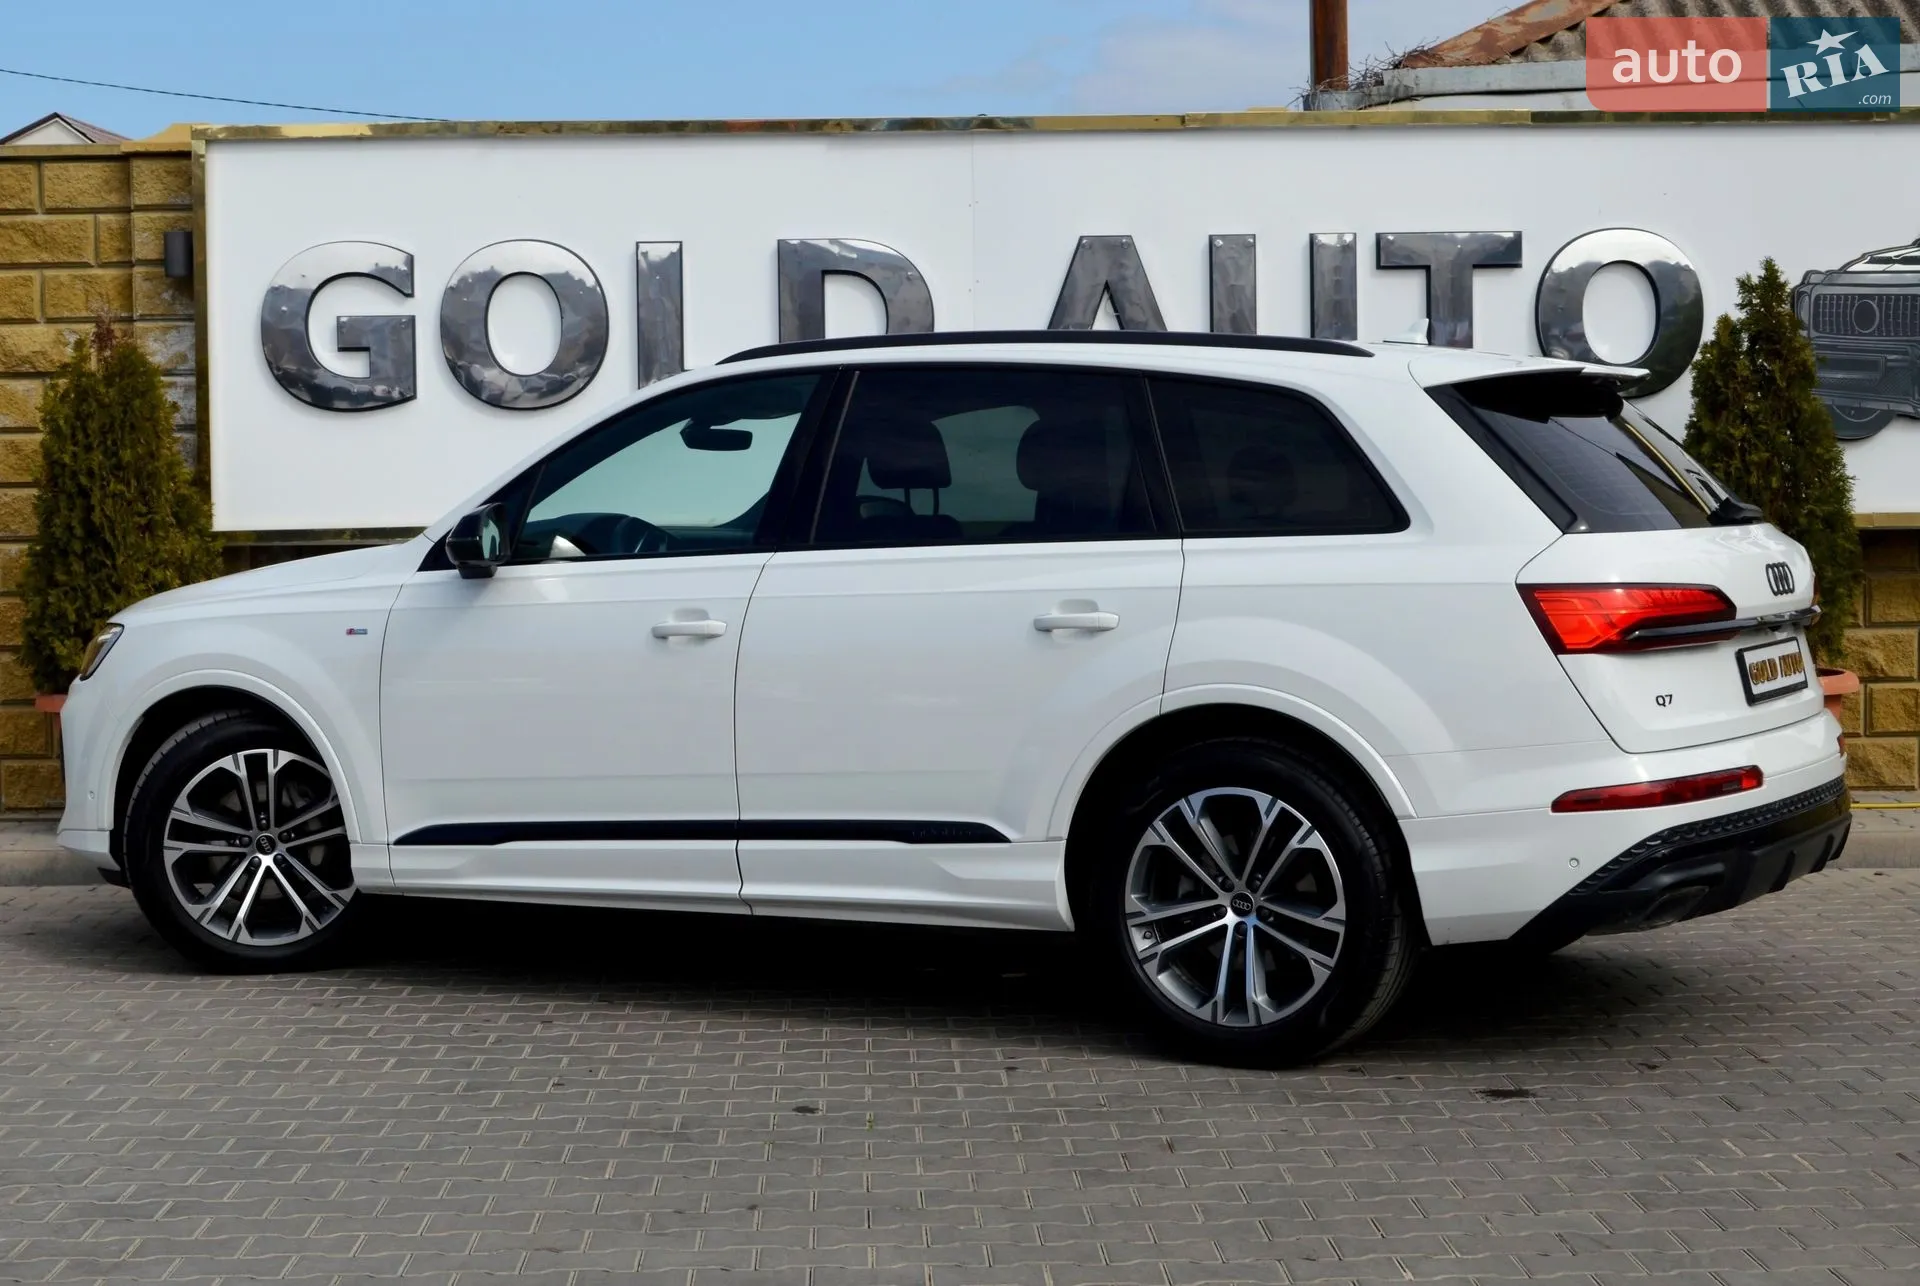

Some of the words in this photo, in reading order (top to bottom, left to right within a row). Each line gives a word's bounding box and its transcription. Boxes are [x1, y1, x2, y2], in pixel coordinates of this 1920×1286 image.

[261, 238, 935, 412] GOLD
[1748, 657, 1779, 686] GOLD
[1655, 694, 1673, 708] Q7
